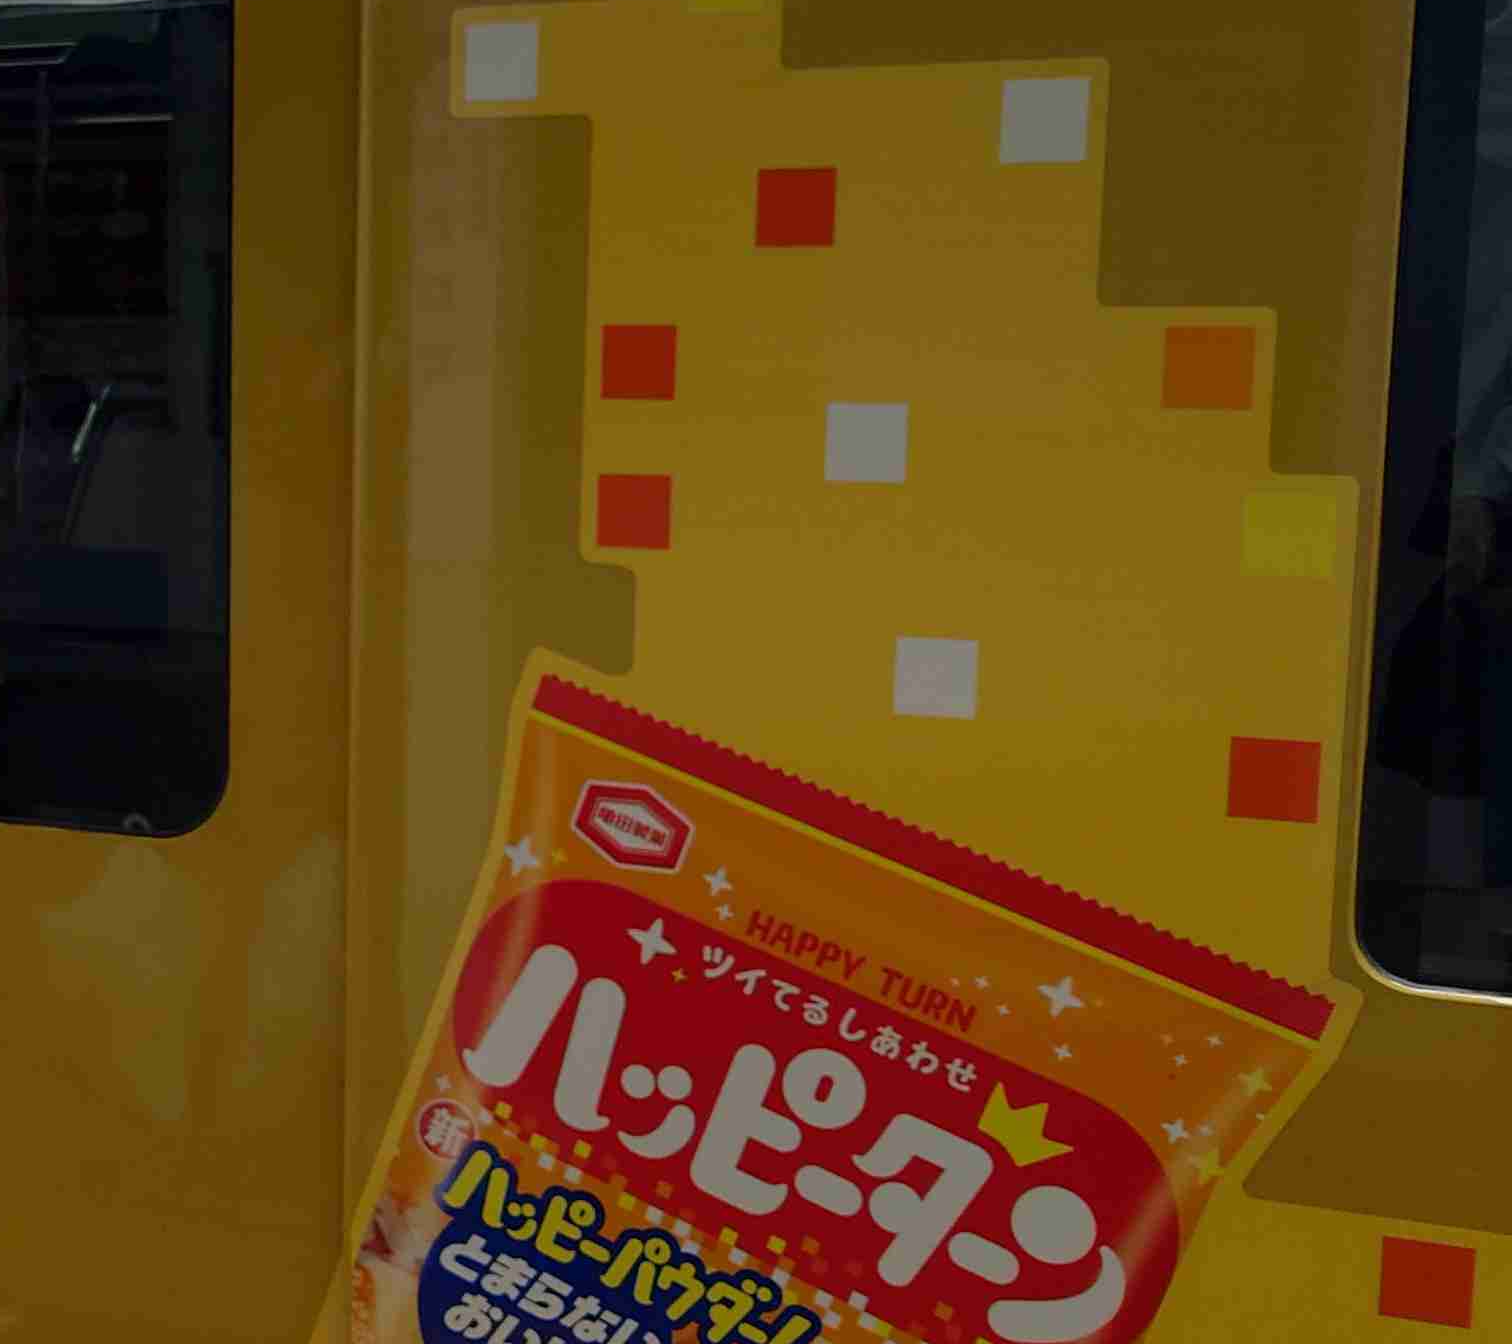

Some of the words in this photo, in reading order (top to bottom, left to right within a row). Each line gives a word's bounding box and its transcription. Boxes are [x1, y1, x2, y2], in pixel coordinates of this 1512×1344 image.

[701, 943, 979, 1094] ツイてるしあわせ
[745, 908, 868, 981] HAPPY
[878, 967, 979, 1033] TURN
[462, 943, 1127, 1344] ハッピーターン
